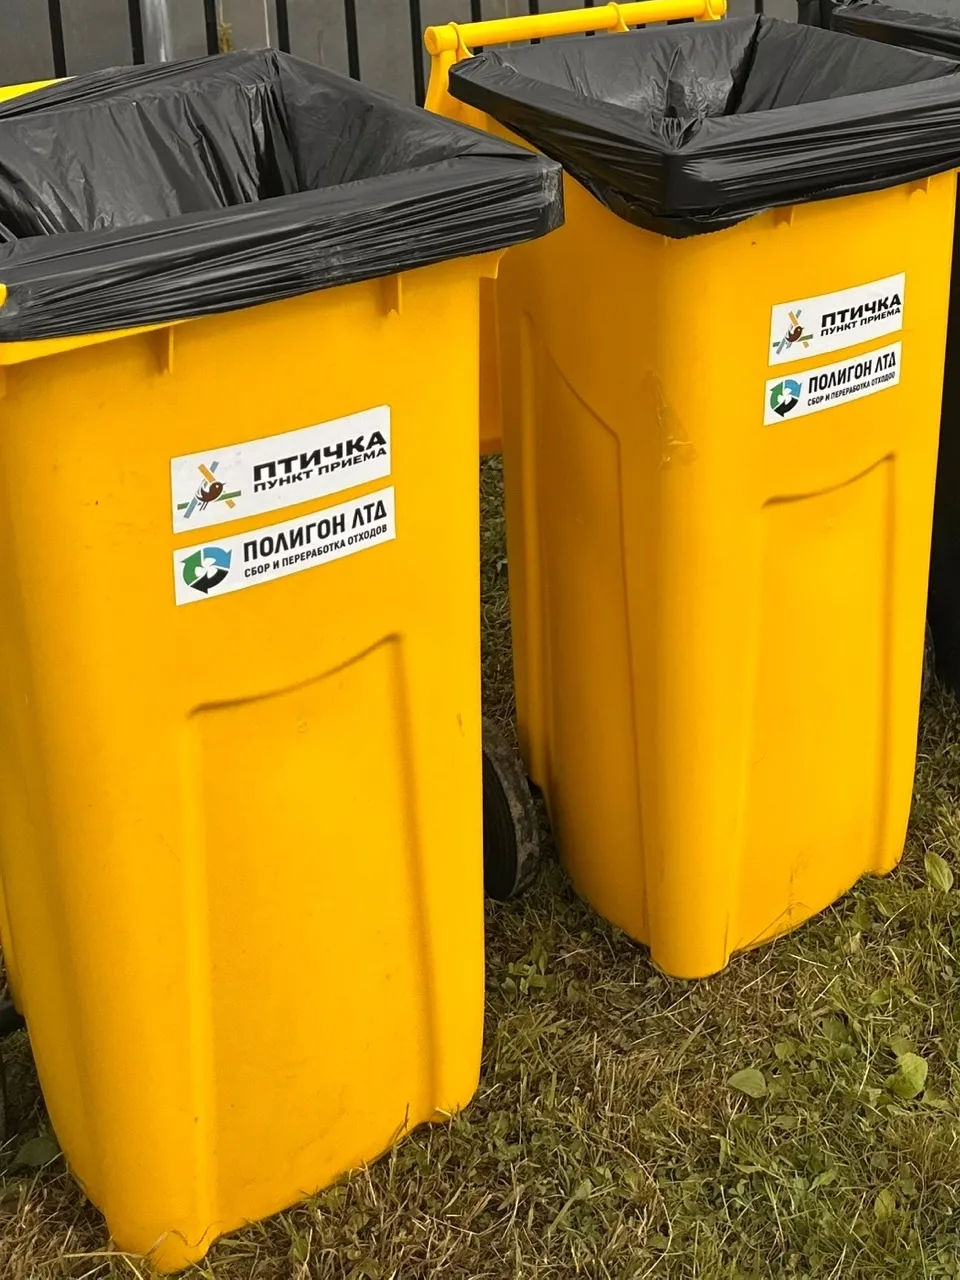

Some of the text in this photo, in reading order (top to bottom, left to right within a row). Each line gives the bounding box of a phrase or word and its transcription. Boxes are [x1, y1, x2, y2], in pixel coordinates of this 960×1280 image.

[820, 307, 901, 337] ПУНКТ ПРИЕМА
[821, 293, 901, 328] ПТИЧКА
[807, 394, 824, 407] СБОР
[825, 392, 830, 401] И
[831, 379, 870, 400] ПЕРЕРАБОТКА
[808, 351, 896, 394] ПОЛИГОН ЛТД
[253, 430, 387, 482] ПТИЧКА
[253, 447, 387, 493] ПУНКТ ПРИЕМА
[243, 500, 388, 562] ПОЛИГОН ЛТД
[244, 523, 388, 578] СБОР И ПЕРЕРАБОТКА ОТХОДОВ
